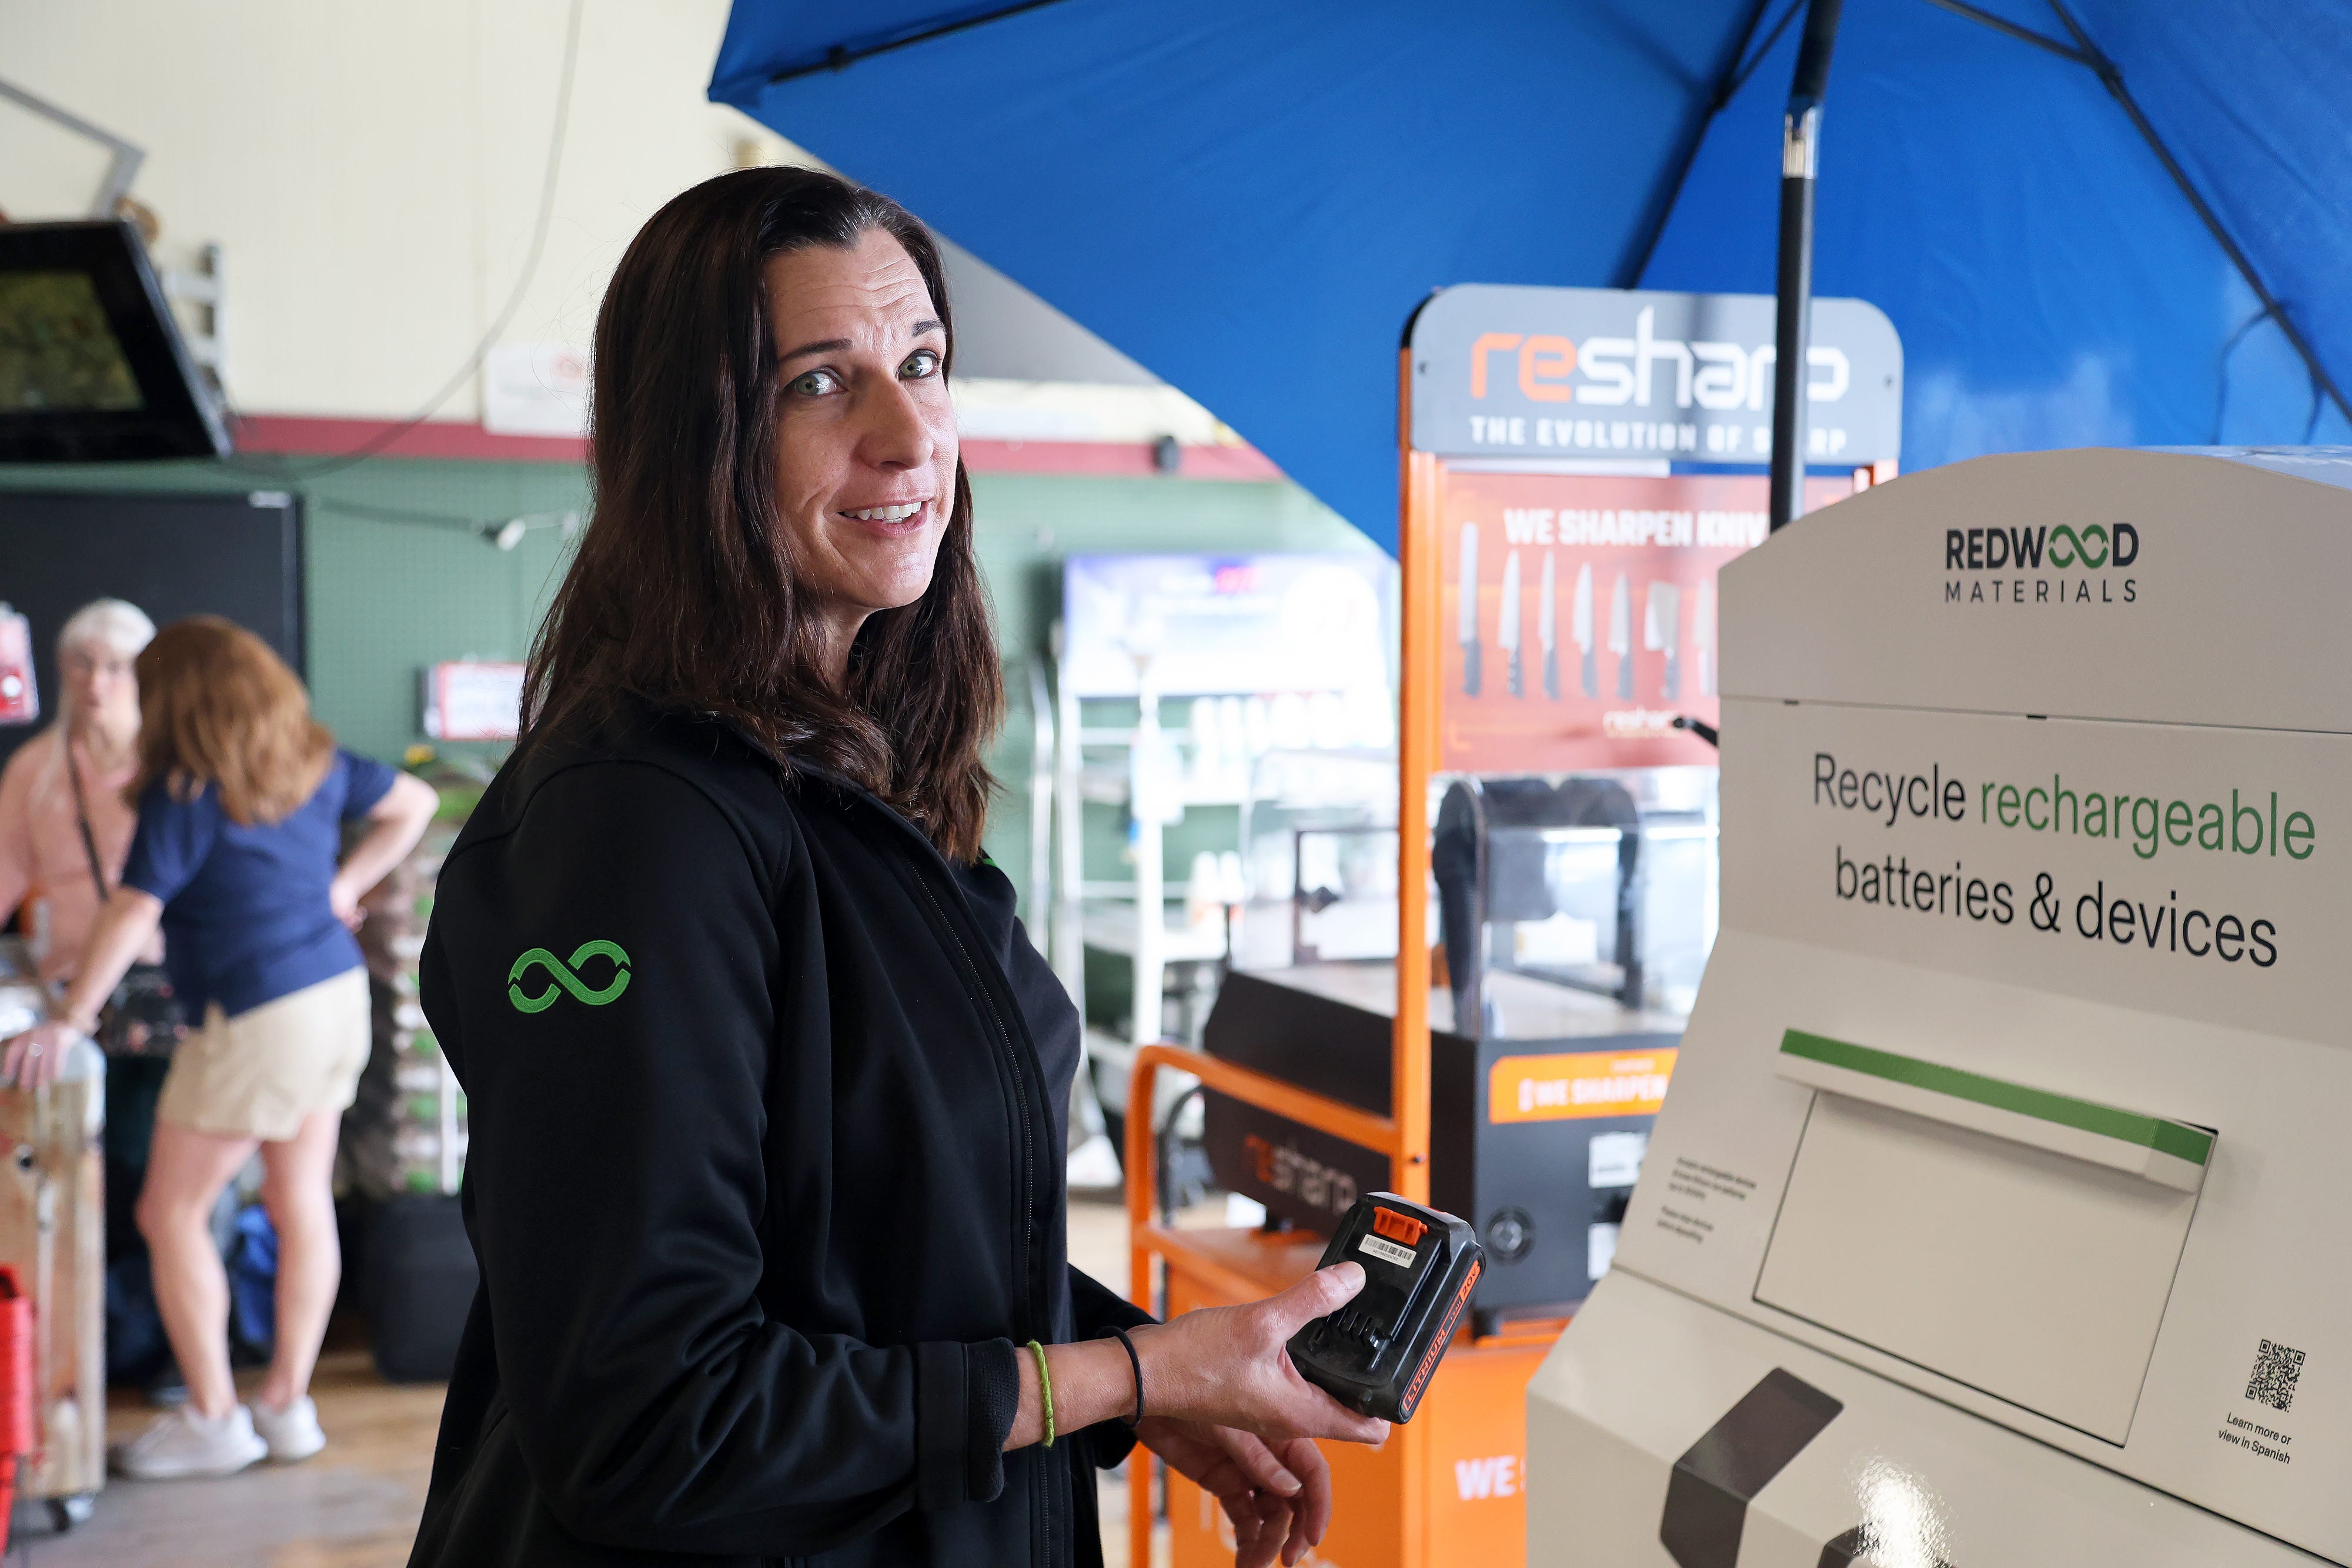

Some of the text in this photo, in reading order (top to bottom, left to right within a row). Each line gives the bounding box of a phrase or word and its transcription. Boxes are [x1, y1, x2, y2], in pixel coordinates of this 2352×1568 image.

[1471, 416, 1526, 445] THE
[1536, 417, 1697, 452] EVOLUTION
[1706, 424, 1742, 453] OF
[1504, 508, 1768, 548] WE SHARPEN KNIV
[1945, 578, 2137, 603] MATERIALS
[1814, 752, 2316, 860] Recycle rechargeable
[1836, 845, 2278, 968] batteries & devices
[1407, 1328, 1445, 1403] LITHIUM
[1462, 1266, 1478, 1296] 20V
[2219, 1430, 2290, 1464] view in Spanish
[2227, 1412, 2292, 1445] Learn more or
[1454, 1455, 1517, 1501] WE
